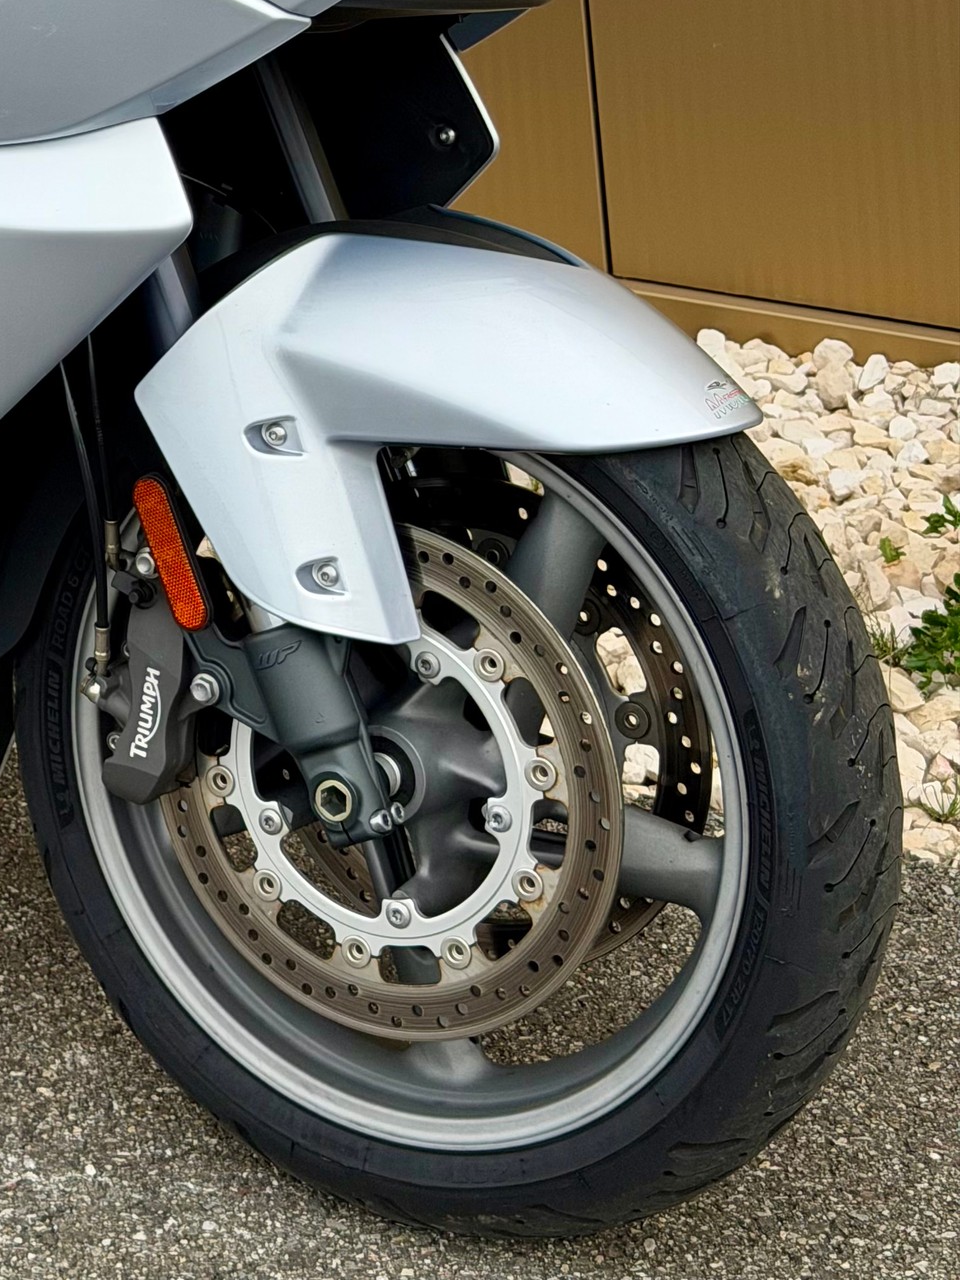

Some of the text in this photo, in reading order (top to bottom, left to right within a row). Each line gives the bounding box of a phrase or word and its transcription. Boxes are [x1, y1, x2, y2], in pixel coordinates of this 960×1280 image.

[52, 591, 75, 649] ROAD
[47, 671, 66, 785] MICHELIN
[129, 667, 161, 758] TRIUMPH
[753, 760, 771, 890] MICHELIN
[742, 908, 765, 975] 120/70
